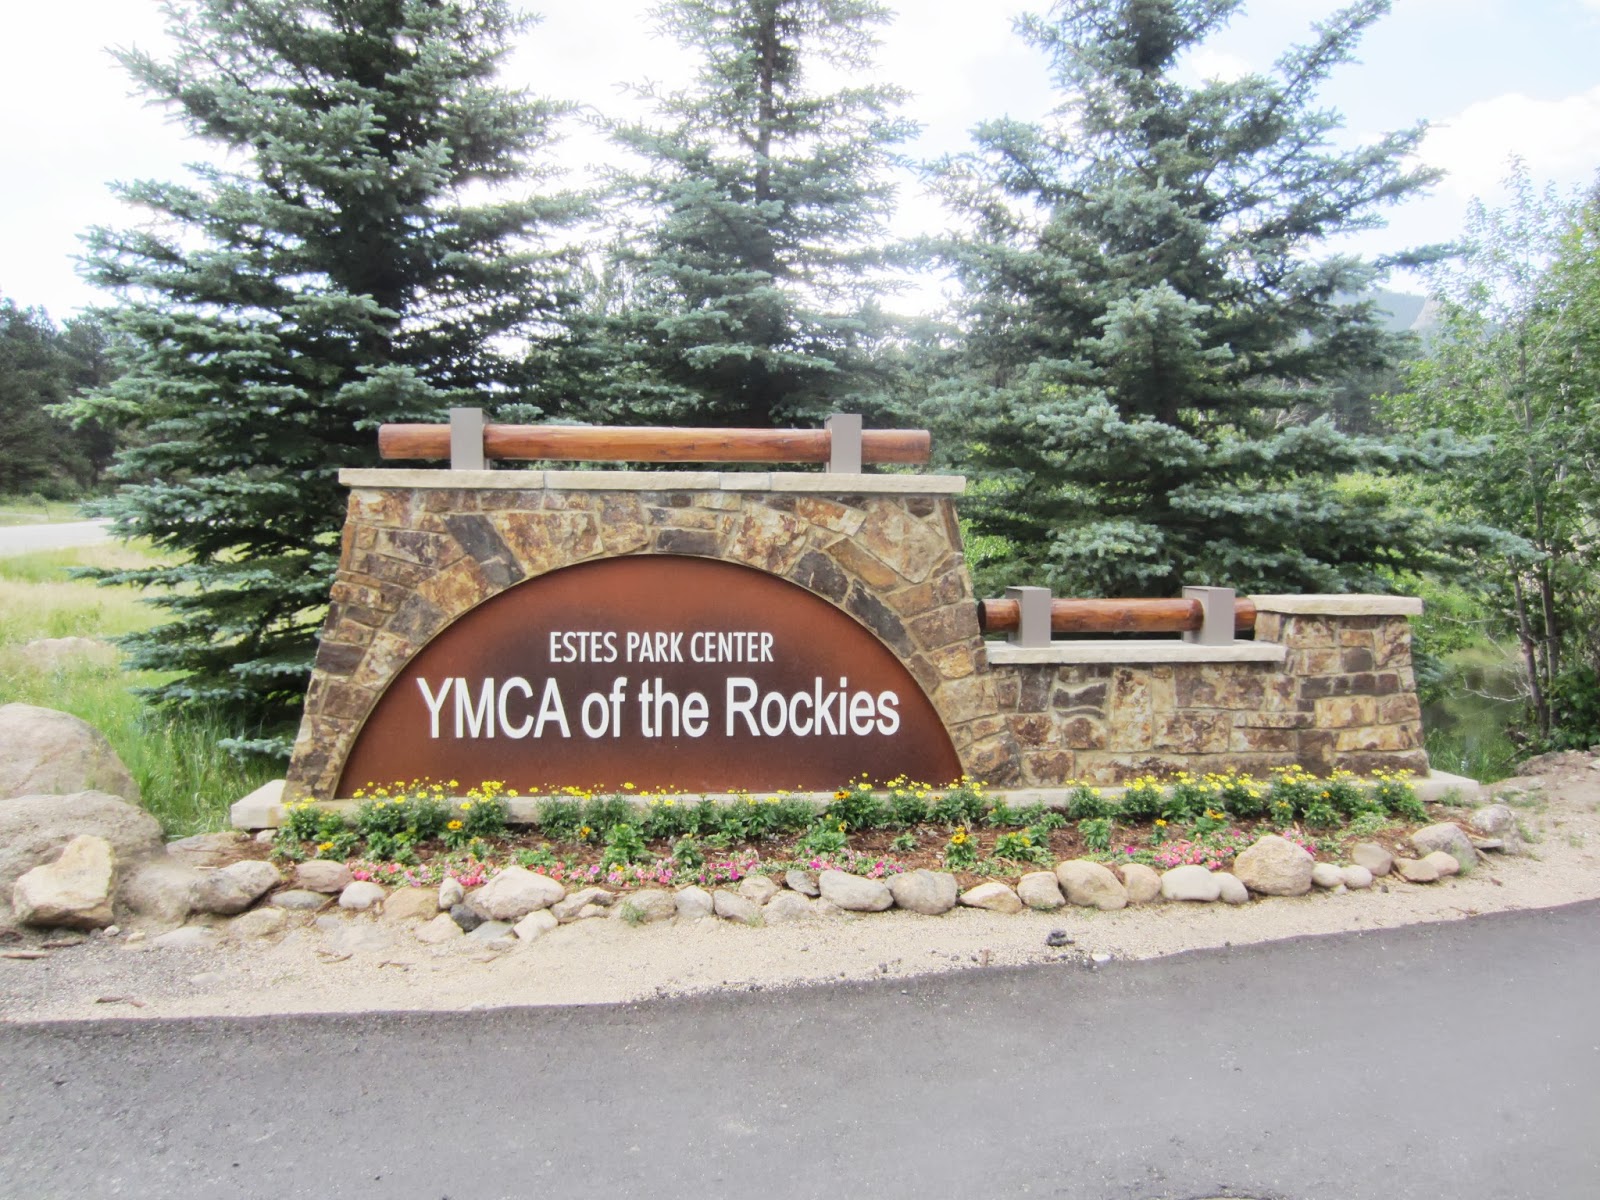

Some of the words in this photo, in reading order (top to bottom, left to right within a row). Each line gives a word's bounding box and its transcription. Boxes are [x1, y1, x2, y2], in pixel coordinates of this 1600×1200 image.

[549, 631, 618, 663] ESTES
[626, 631, 684, 663] PARK
[690, 631, 774, 663] CENTER
[416, 676, 572, 739] YMCA
[581, 676, 628, 739] of
[638, 677, 710, 738] the
[726, 676, 901, 737] Rockies
